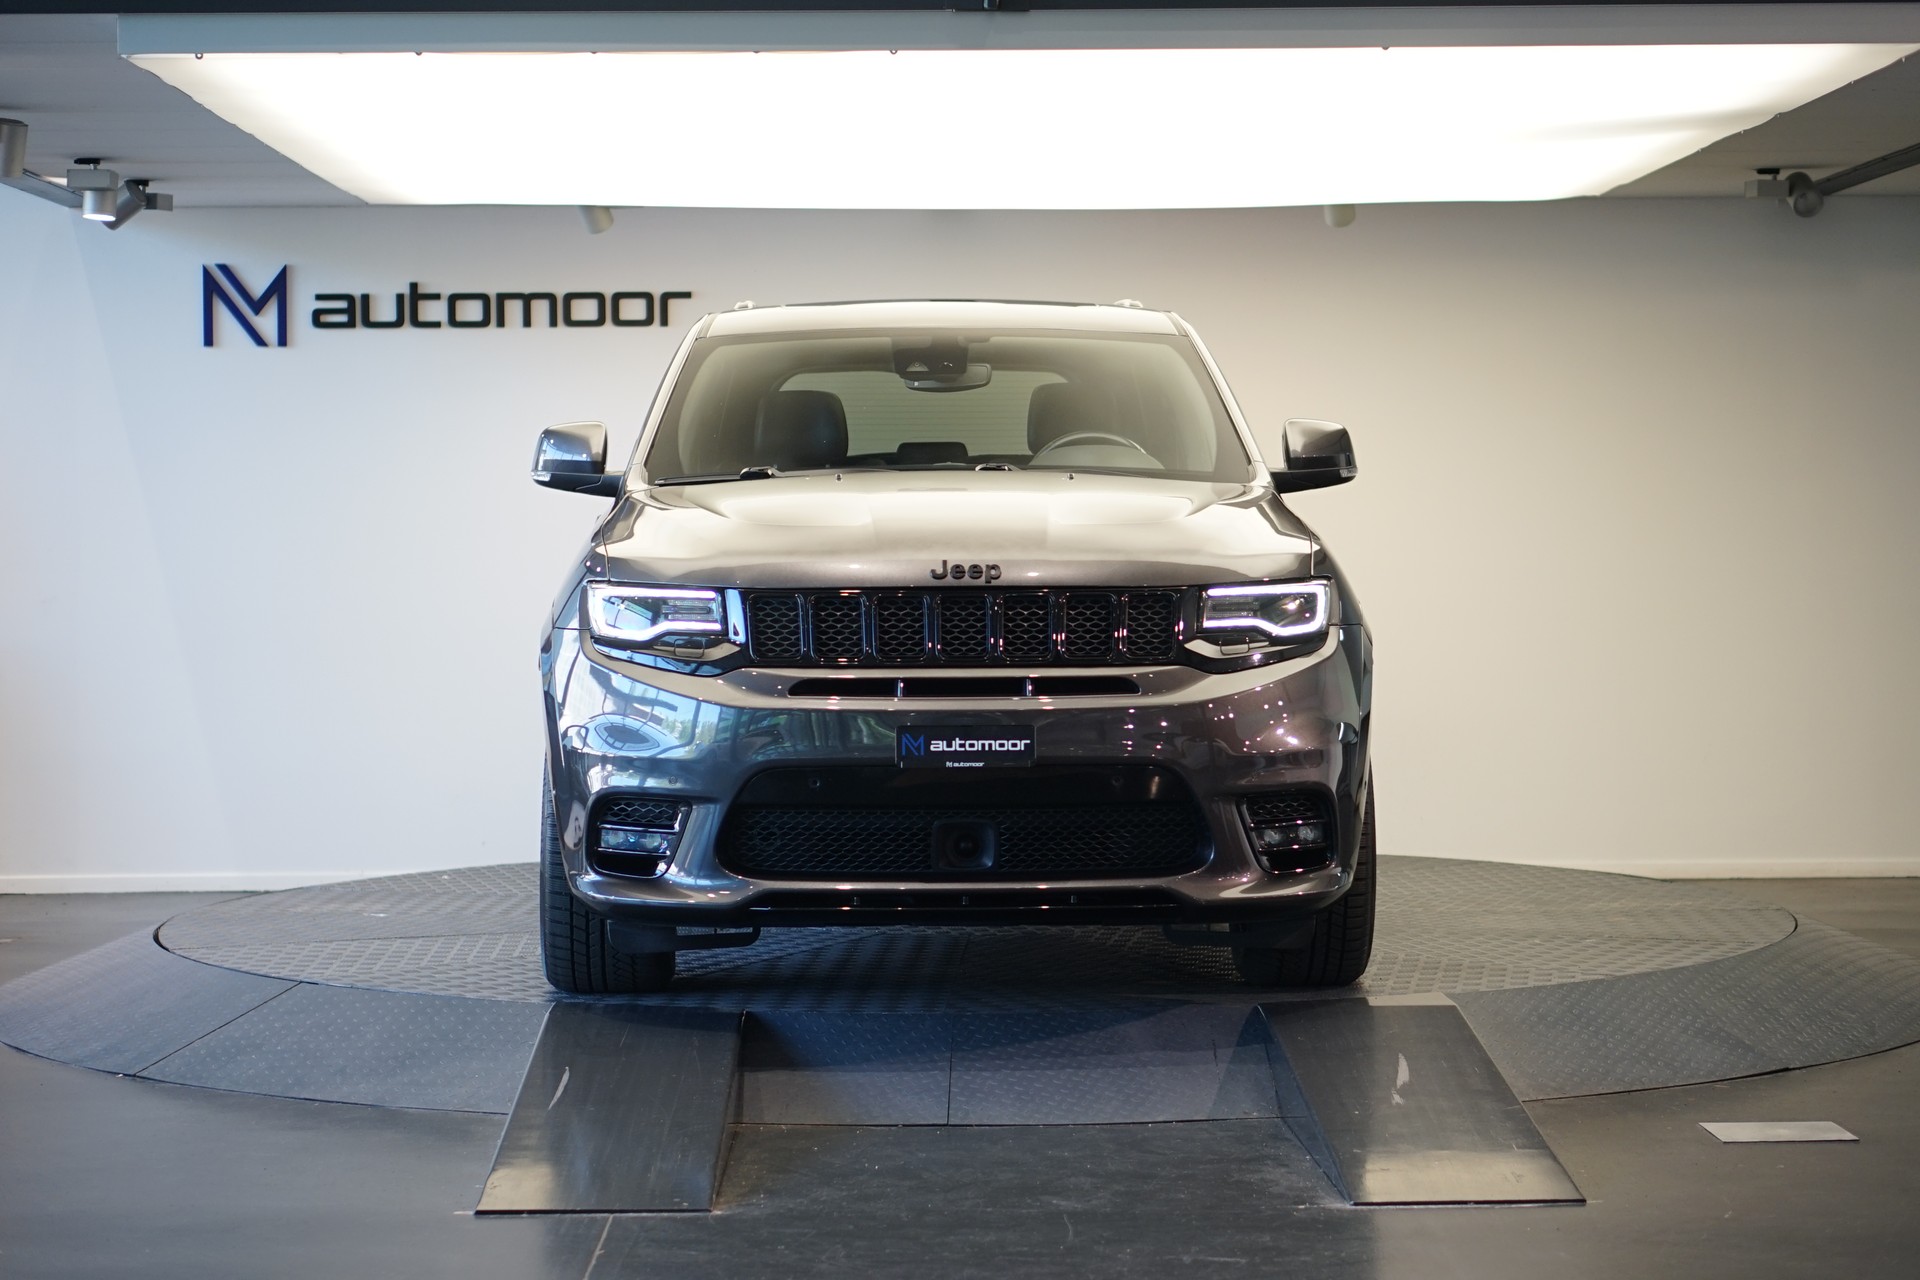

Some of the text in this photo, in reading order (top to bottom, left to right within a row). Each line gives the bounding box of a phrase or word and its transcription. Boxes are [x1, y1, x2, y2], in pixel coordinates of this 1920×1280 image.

[311, 281, 692, 329] automoor
[930, 560, 1002, 584] Jeep
[930, 737, 1031, 751] automoor
